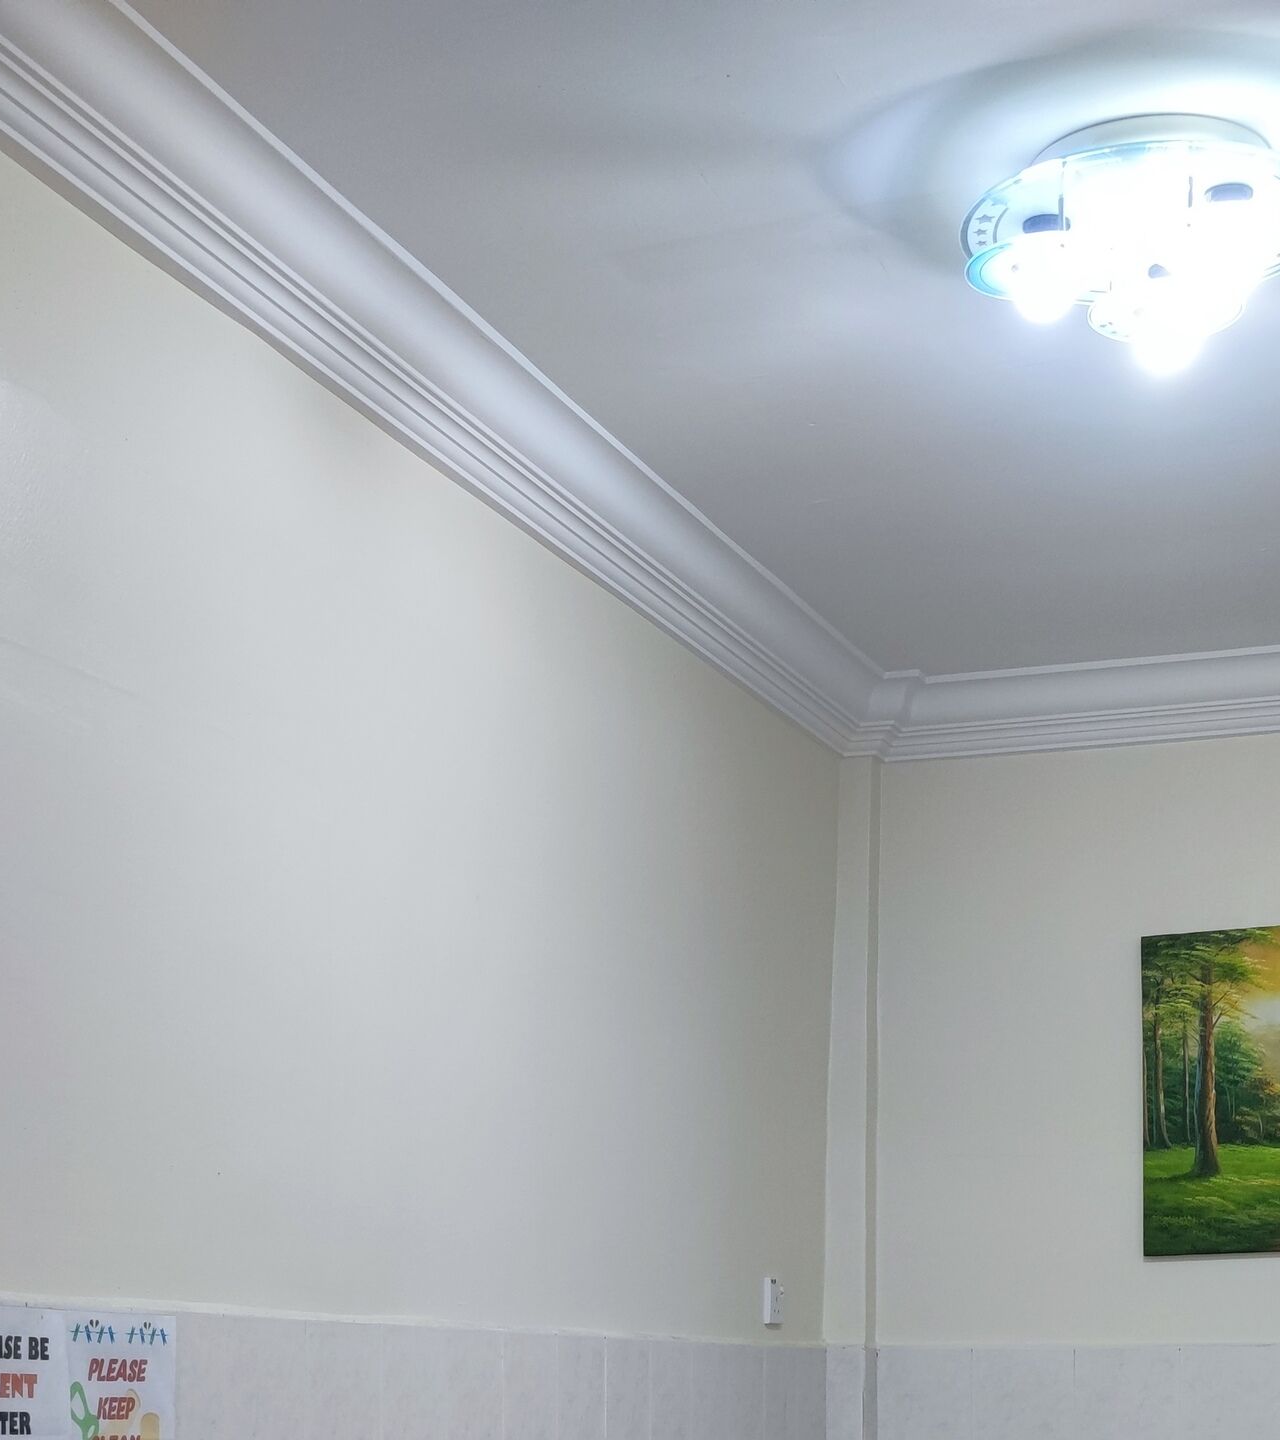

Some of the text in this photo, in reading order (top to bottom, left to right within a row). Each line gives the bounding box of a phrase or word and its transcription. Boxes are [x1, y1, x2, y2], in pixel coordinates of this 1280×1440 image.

[28, 1337, 50, 1360] BE
[88, 1358, 148, 1382] PLEASE
[96, 1397, 136, 1420] KEEP
